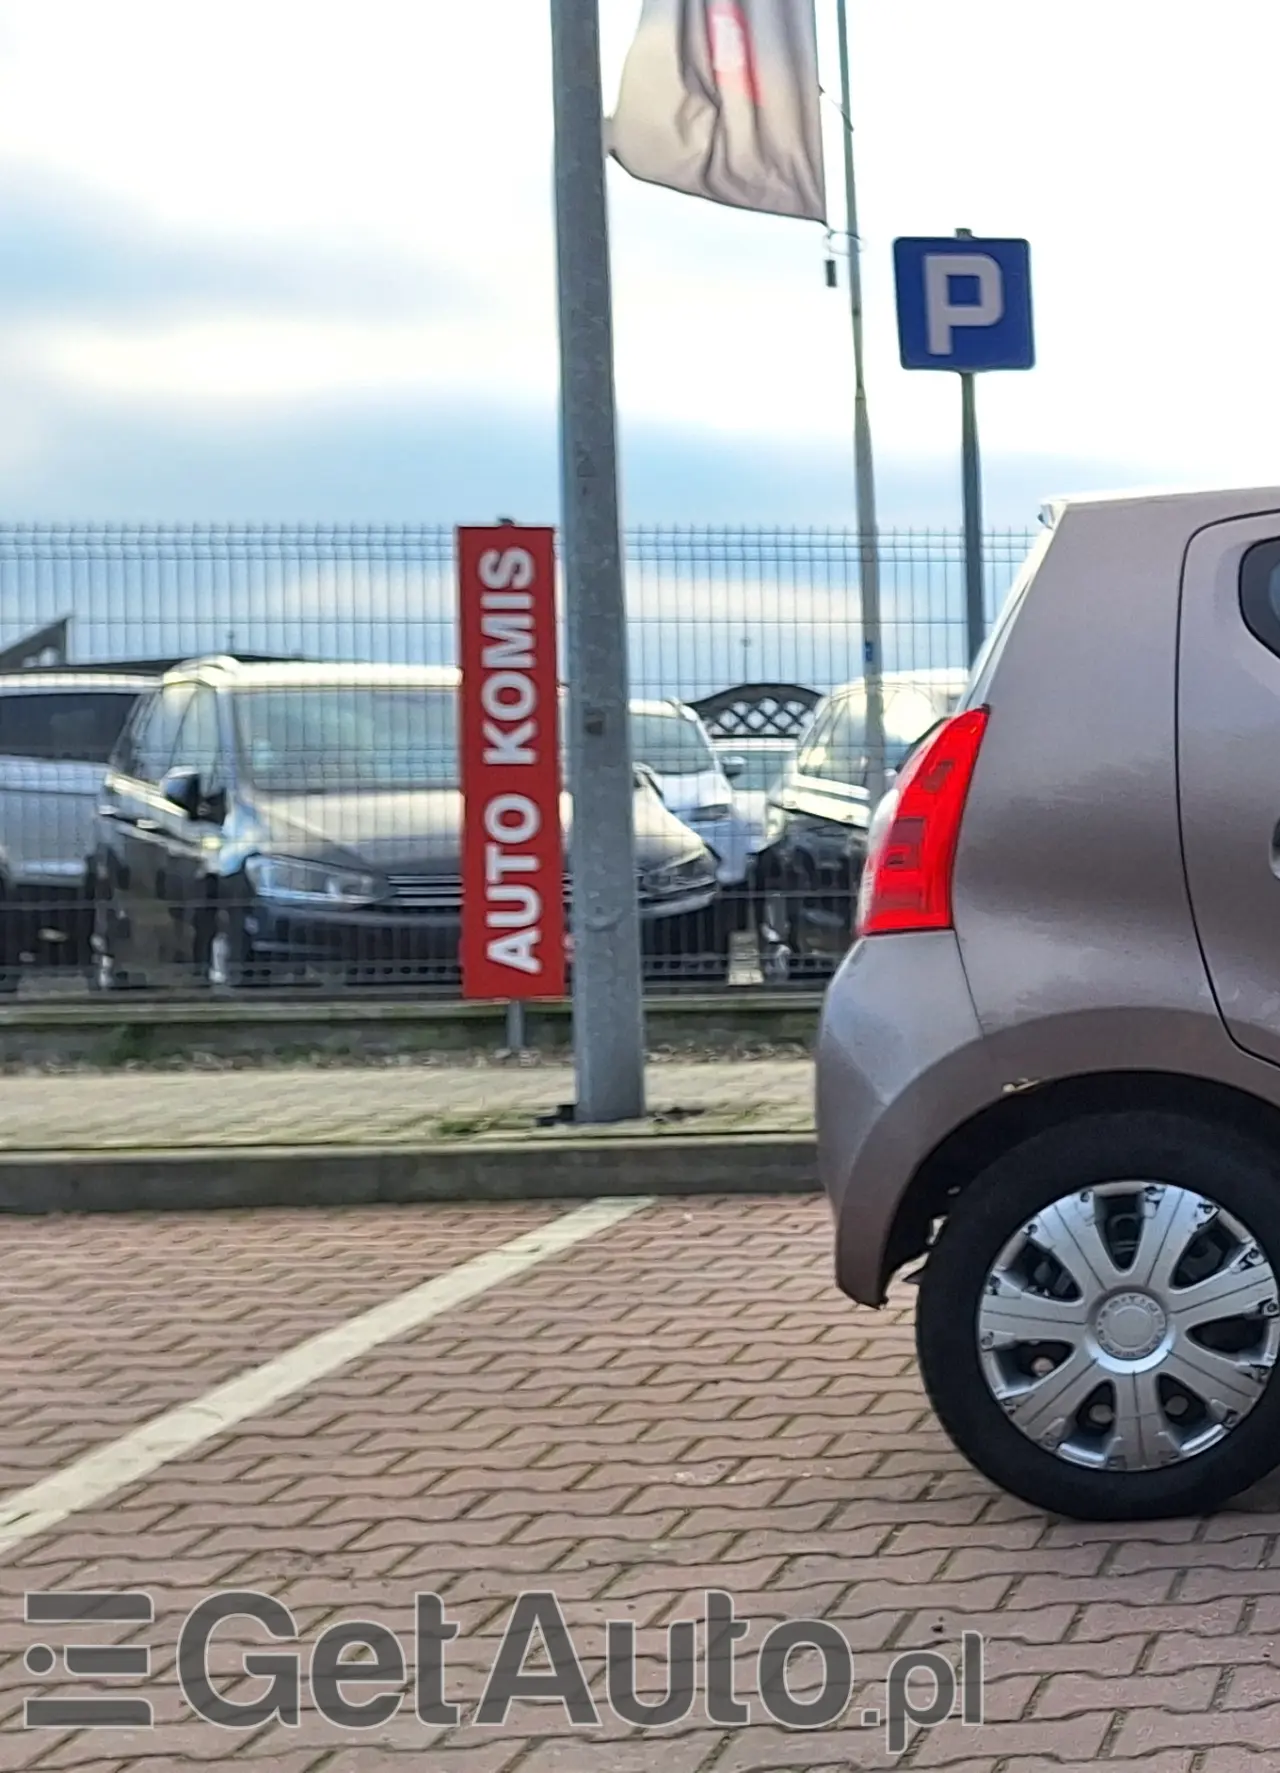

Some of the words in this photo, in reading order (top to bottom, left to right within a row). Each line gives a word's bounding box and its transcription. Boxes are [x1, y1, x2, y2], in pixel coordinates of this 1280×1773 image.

[924, 254, 1005, 356] P
[479, 547, 536, 763] KOMIS
[484, 792, 542, 974] AUTO
